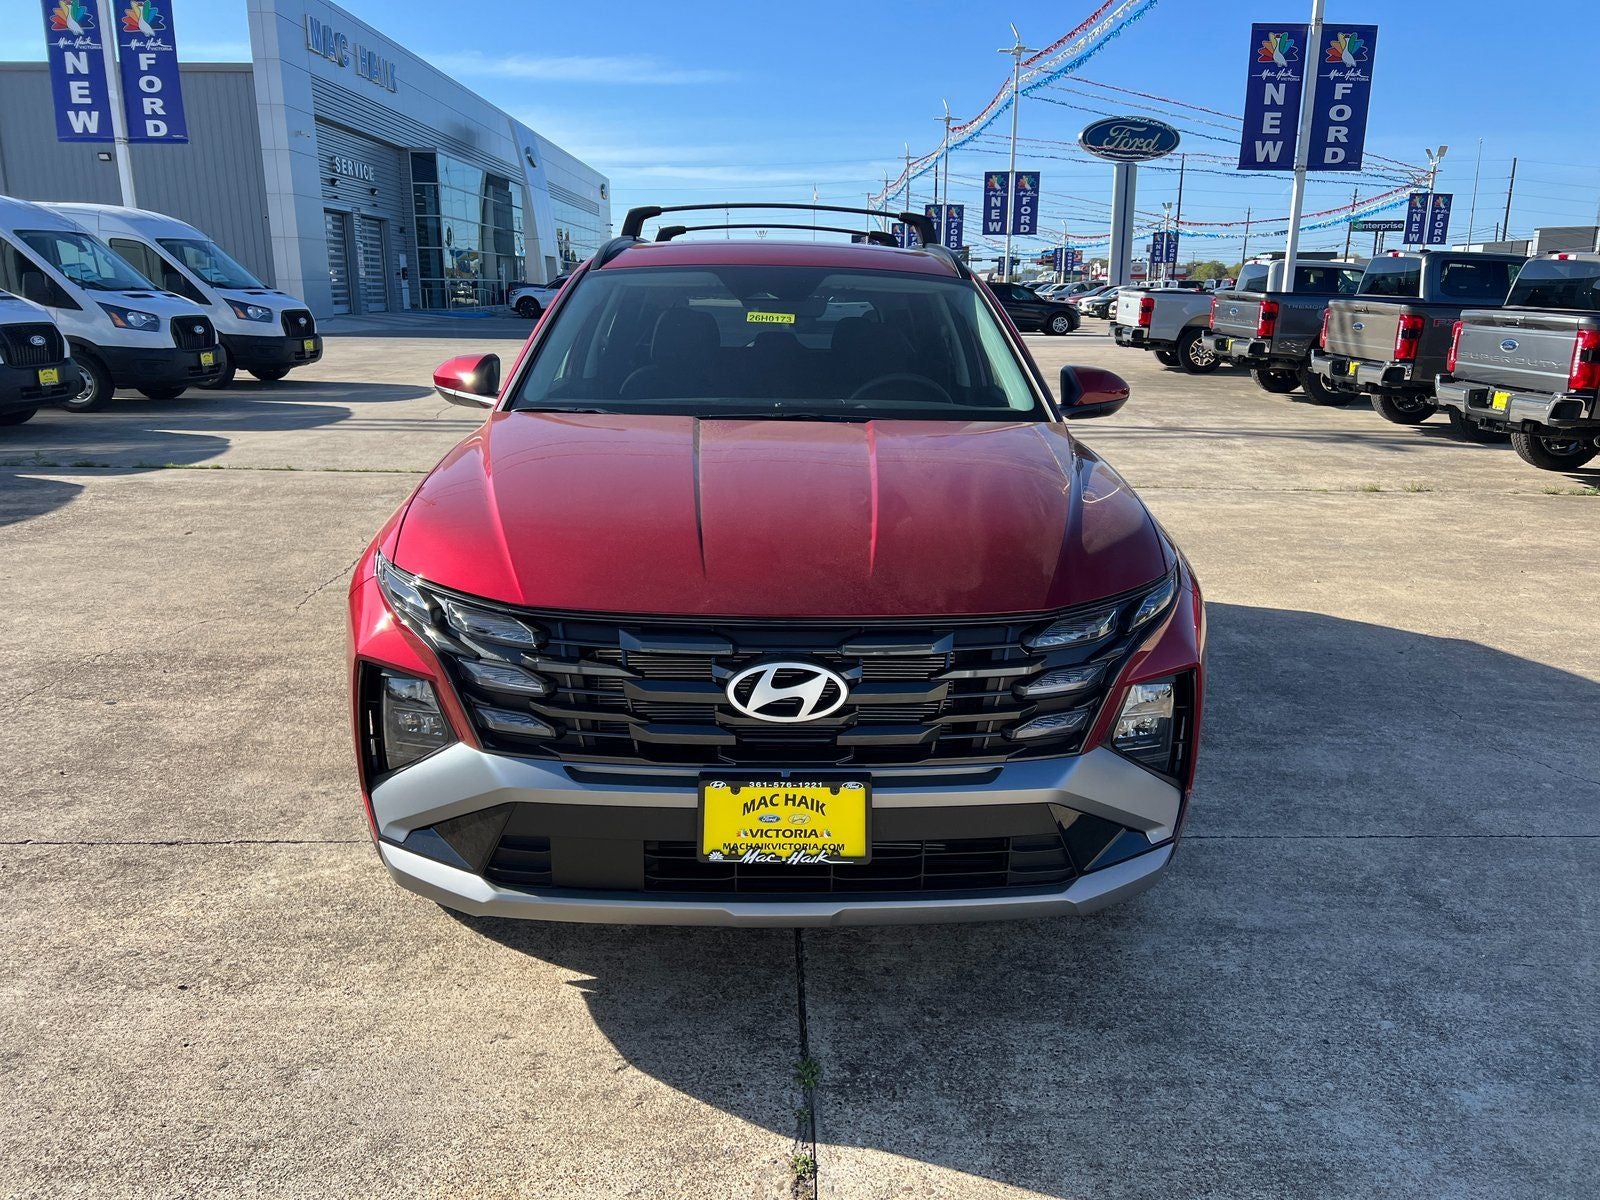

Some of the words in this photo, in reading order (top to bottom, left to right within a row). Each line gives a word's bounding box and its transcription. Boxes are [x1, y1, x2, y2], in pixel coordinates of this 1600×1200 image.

[304, 13, 350, 68] MAC
[353, 43, 398, 94] HAIK
[64, 51, 99, 134] NEW
[138, 53, 168, 138] FORD
[1254, 83, 1286, 163] NEW
[1323, 83, 1353, 164] FORD
[1102, 125, 1161, 151] Ford
[334, 156, 375, 182] SERVICE
[988, 196, 1002, 232] NEW
[1020, 197, 1031, 233] FORD
[1355, 221, 1404, 232] enterprise
[949, 222, 958, 248] FORD
[1408, 213, 1421, 242] NEW
[1432, 213, 1444, 243] FORD
[1154, 244, 1162, 262] NEW
[749, 314, 792, 323] 26H0173
[1461, 351, 1510, 364] SUPER
[1515, 356, 1564, 369] DUTY
[742, 793, 780, 816] MAC
[784, 793, 827, 816] HAIK
[760, 814, 780, 823] Ford
[749, 828, 819, 838] VICTORIA
[722, 842, 845, 851] MACHAIKVICTORIA.COM
[740, 848, 782, 864] Mac
[786, 849, 832, 865] Haik
